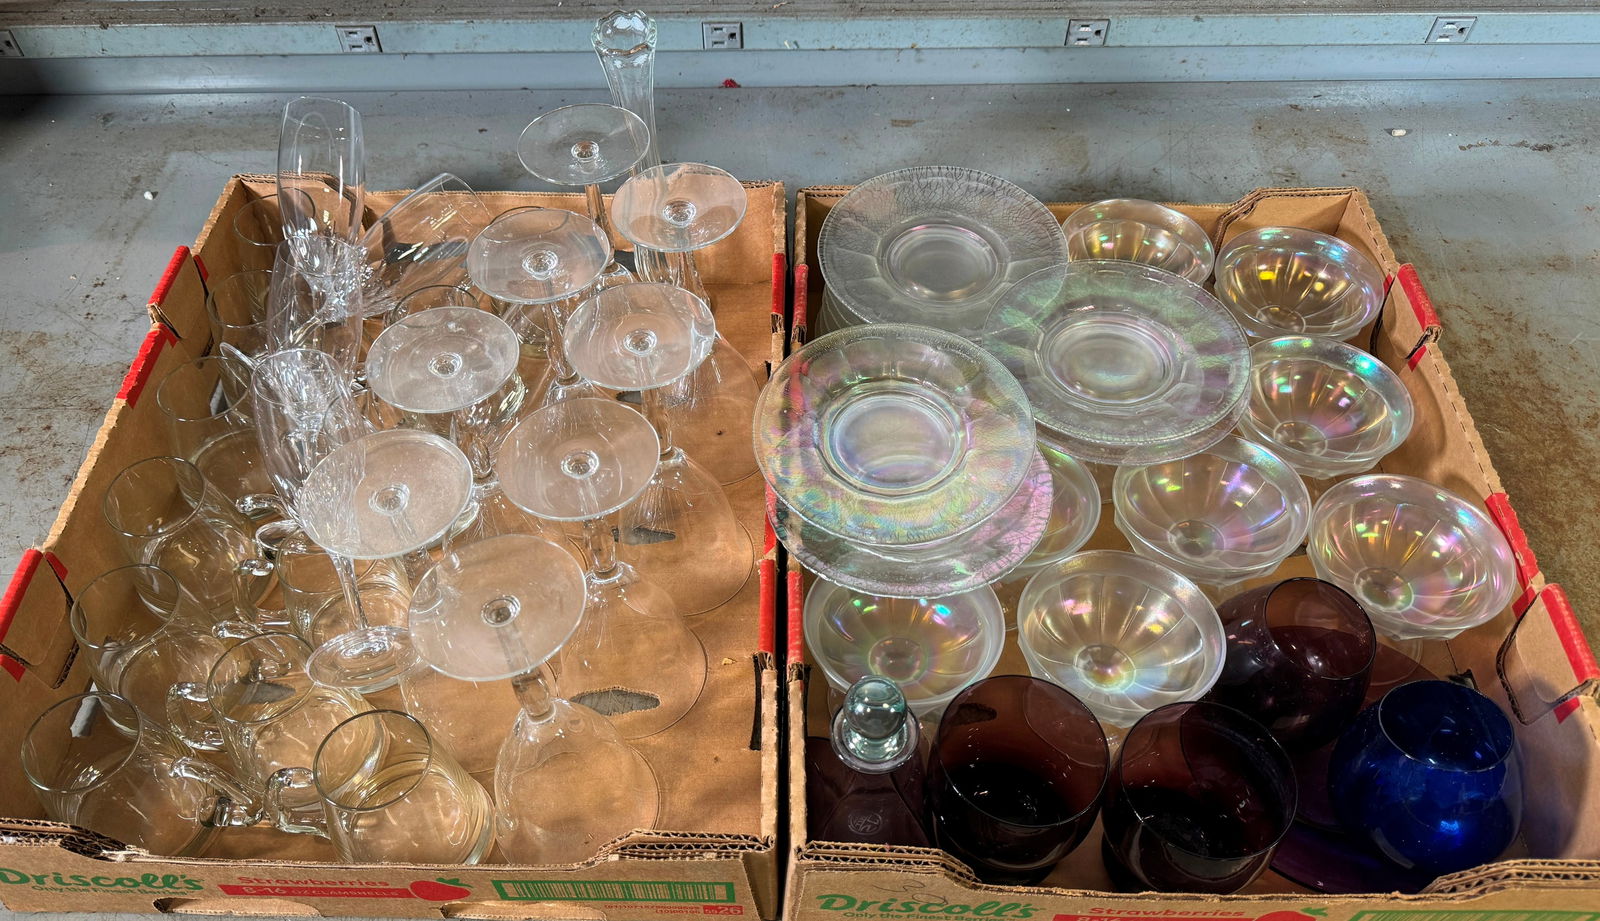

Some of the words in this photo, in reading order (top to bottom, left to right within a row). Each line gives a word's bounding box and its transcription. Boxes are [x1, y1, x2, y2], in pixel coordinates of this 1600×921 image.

[0, 868, 204, 890] Driscoll's
[237, 876, 390, 887] Strawberries
[816, 894, 1041, 918] Driscoll's
[1088, 907, 1246, 917] Strawberries
